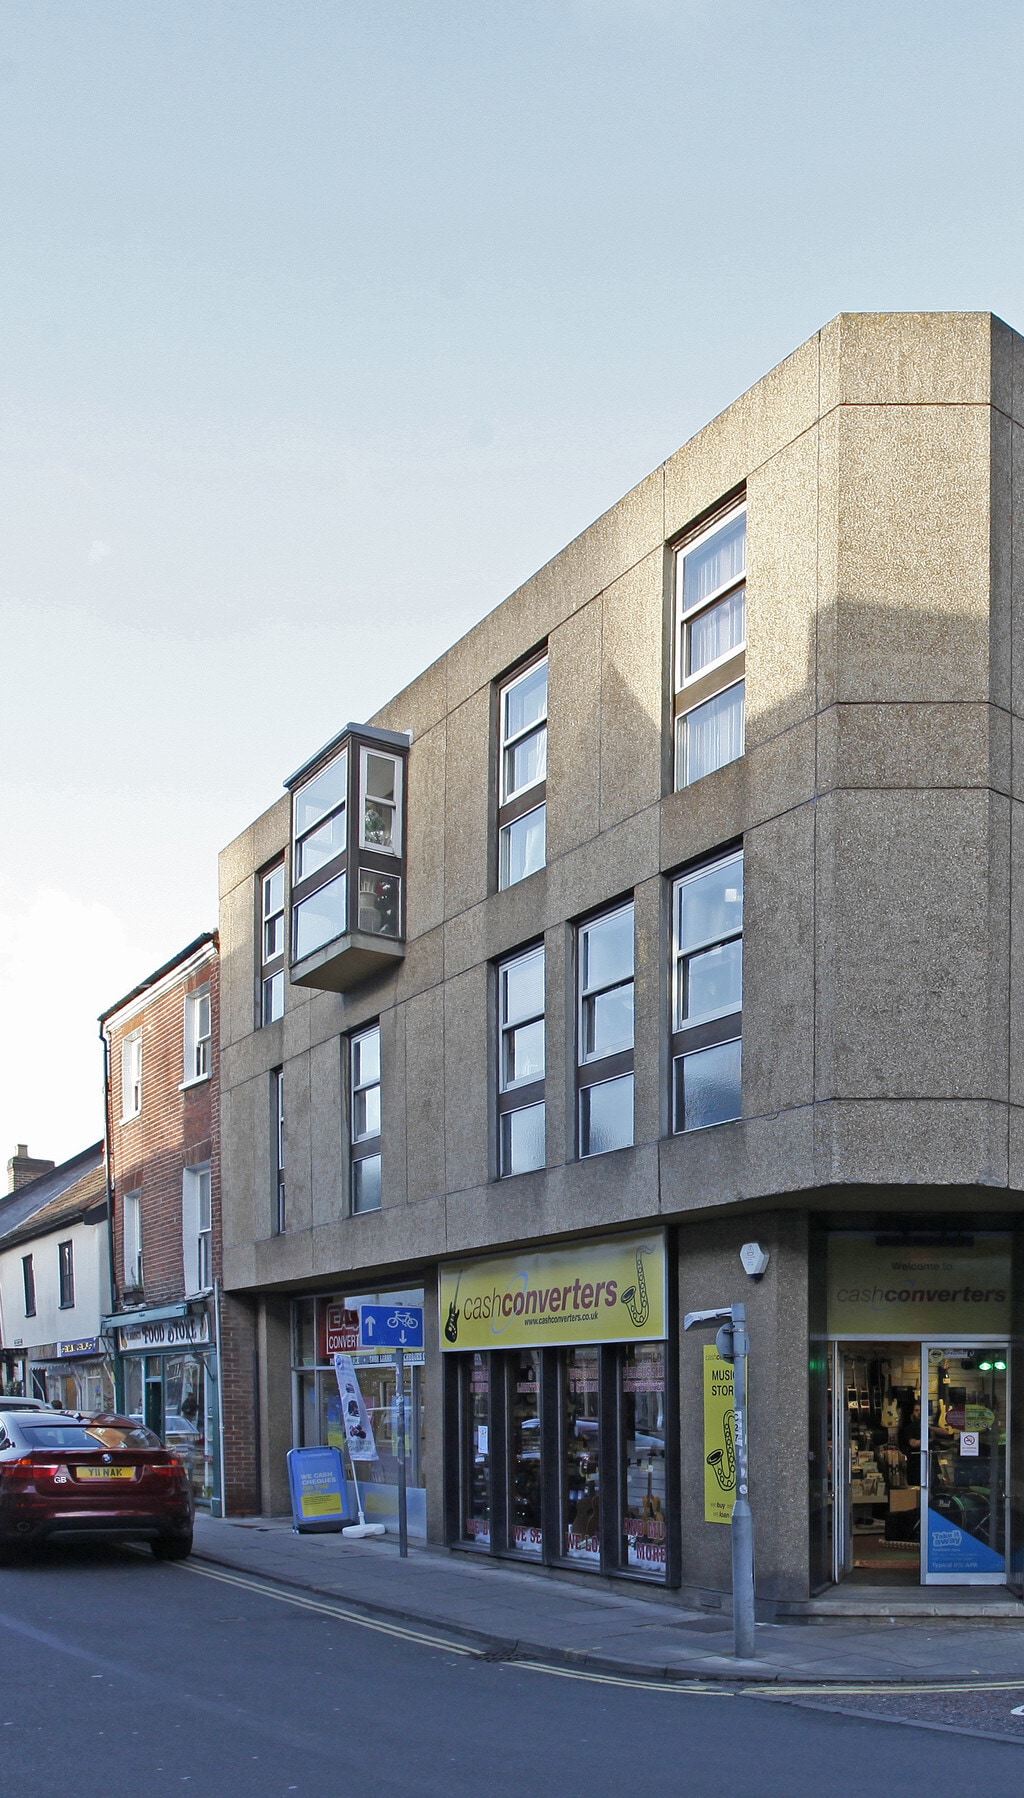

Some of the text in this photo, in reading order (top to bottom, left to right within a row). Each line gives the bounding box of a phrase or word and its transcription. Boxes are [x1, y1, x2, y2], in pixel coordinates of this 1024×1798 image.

[891, 1261, 953, 1271] Welcome to
[463, 1278, 618, 1320] cashconverters
[836, 1285, 1007, 1303] cashconverters
[524, 1310, 599, 1326] www.cashconverters.co.uk
[142, 1323, 165, 1344] FOOD
[168, 1318, 197, 1344] STORE
[623, 1366, 664, 1378] PERCUSSIO
[711, 1370, 735, 1381] MUSI
[711, 1385, 734, 1396] STOR
[103, 1468, 123, 1477] NAK
[53, 1476, 67, 1484] GB
[301, 1477, 337, 1486] CHEQUES
[467, 1519, 479, 1535] WE
[624, 1518, 666, 1540] AND MU
[512, 1525, 542, 1544] WE SE
[933, 1532, 953, 1540] Take
[934, 1537, 961, 1546] away
[566, 1532, 600, 1553] WE LO
[636, 1542, 666, 1563] MORE
